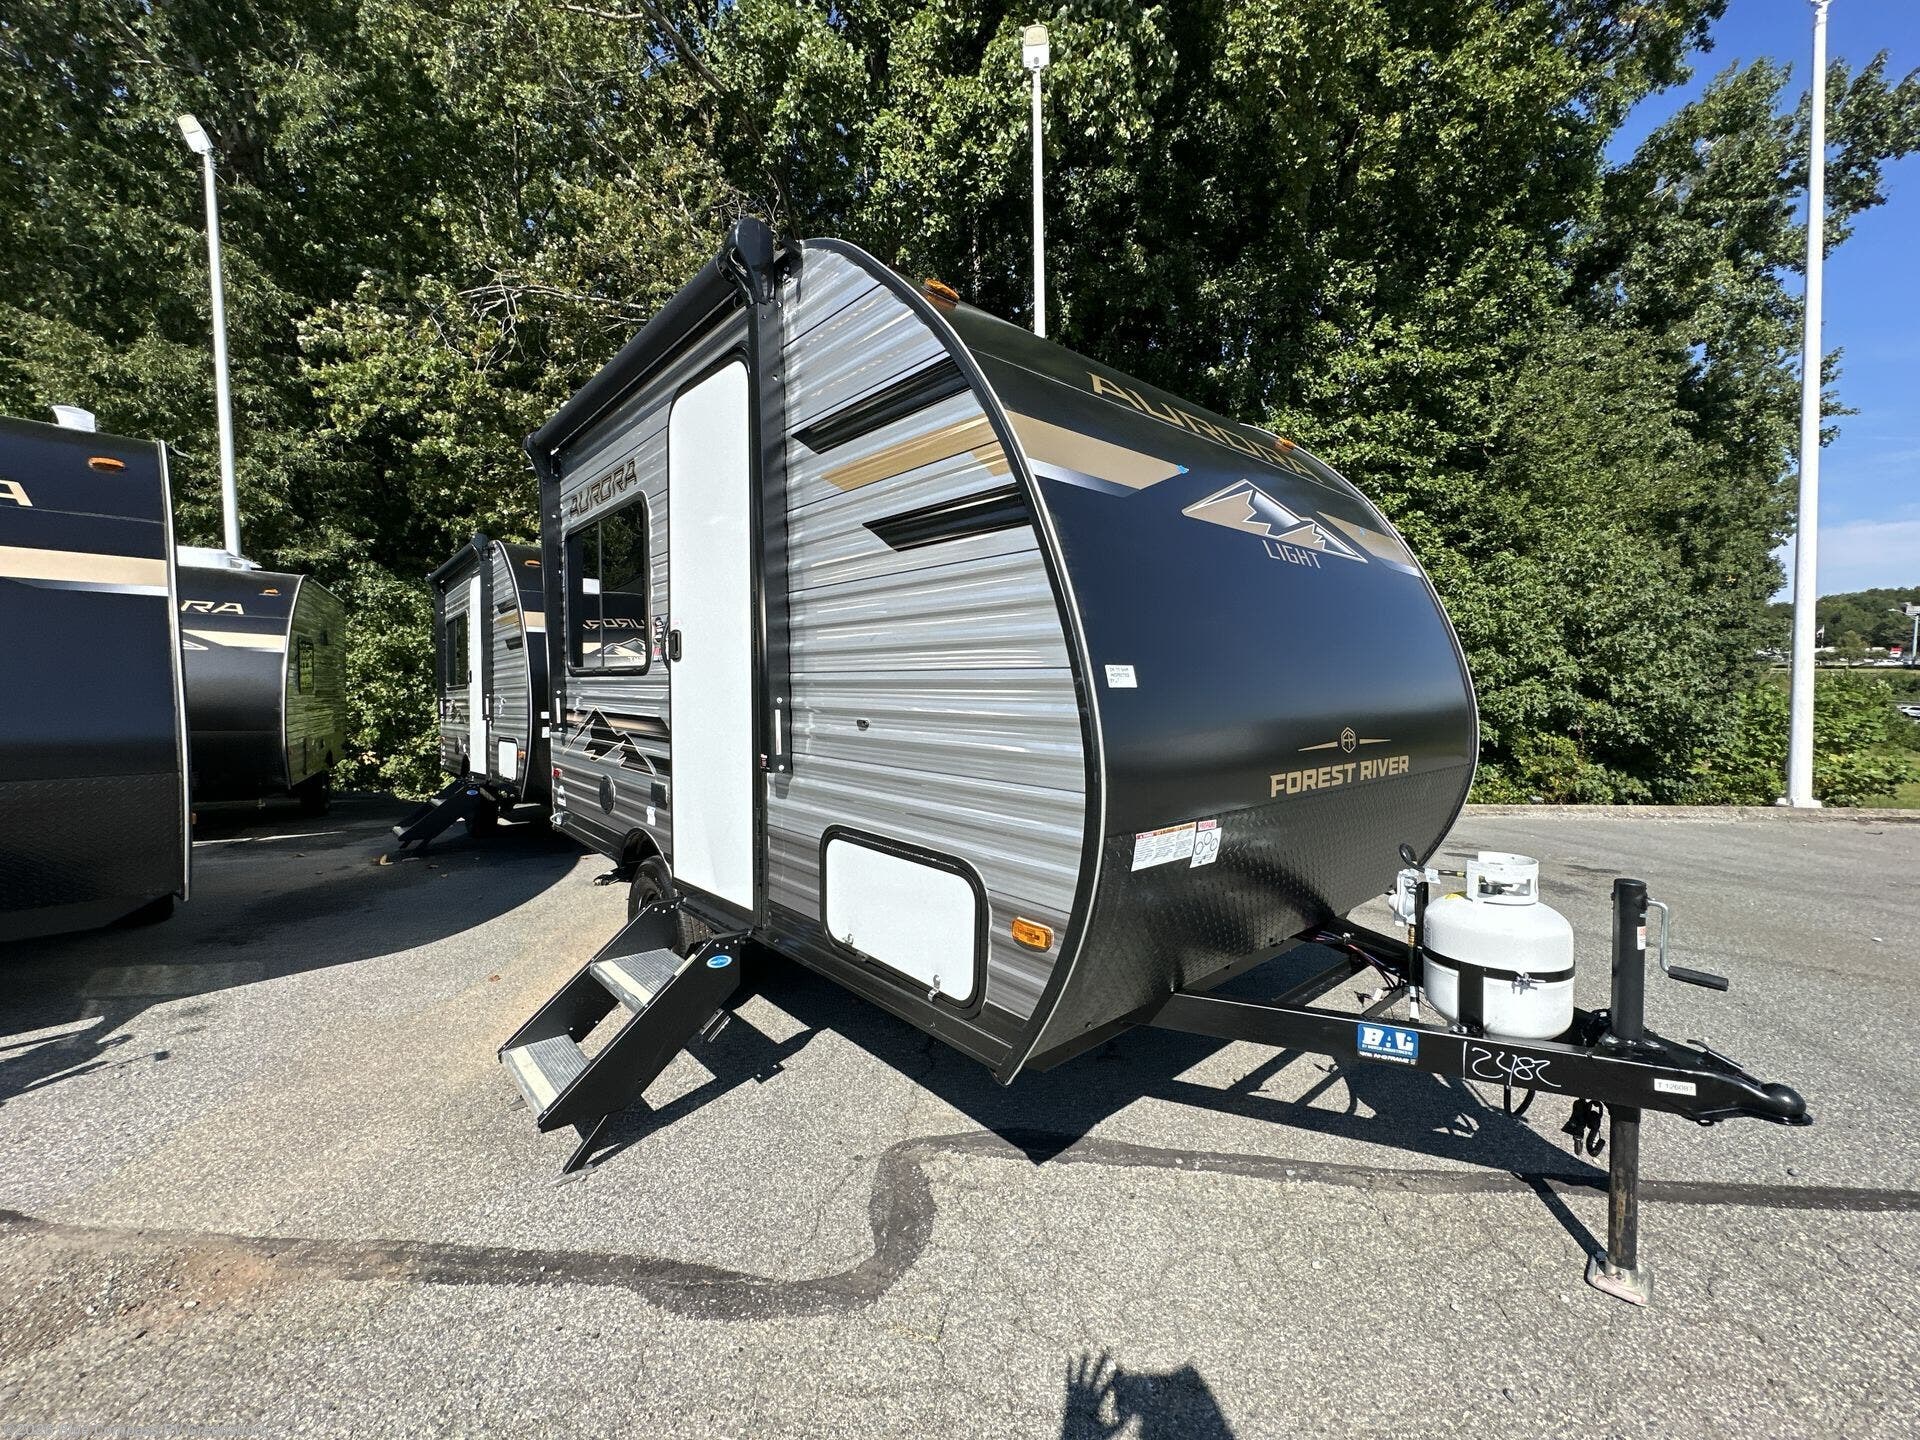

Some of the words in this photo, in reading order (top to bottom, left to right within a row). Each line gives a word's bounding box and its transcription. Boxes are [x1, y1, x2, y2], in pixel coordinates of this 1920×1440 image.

[1087, 372, 1323, 484] AURORA
[569, 458, 638, 517] AURORA
[1262, 539, 1321, 569] LIGHT
[1270, 763, 1356, 798] FOREST
[1360, 755, 1410, 781] RIVER
